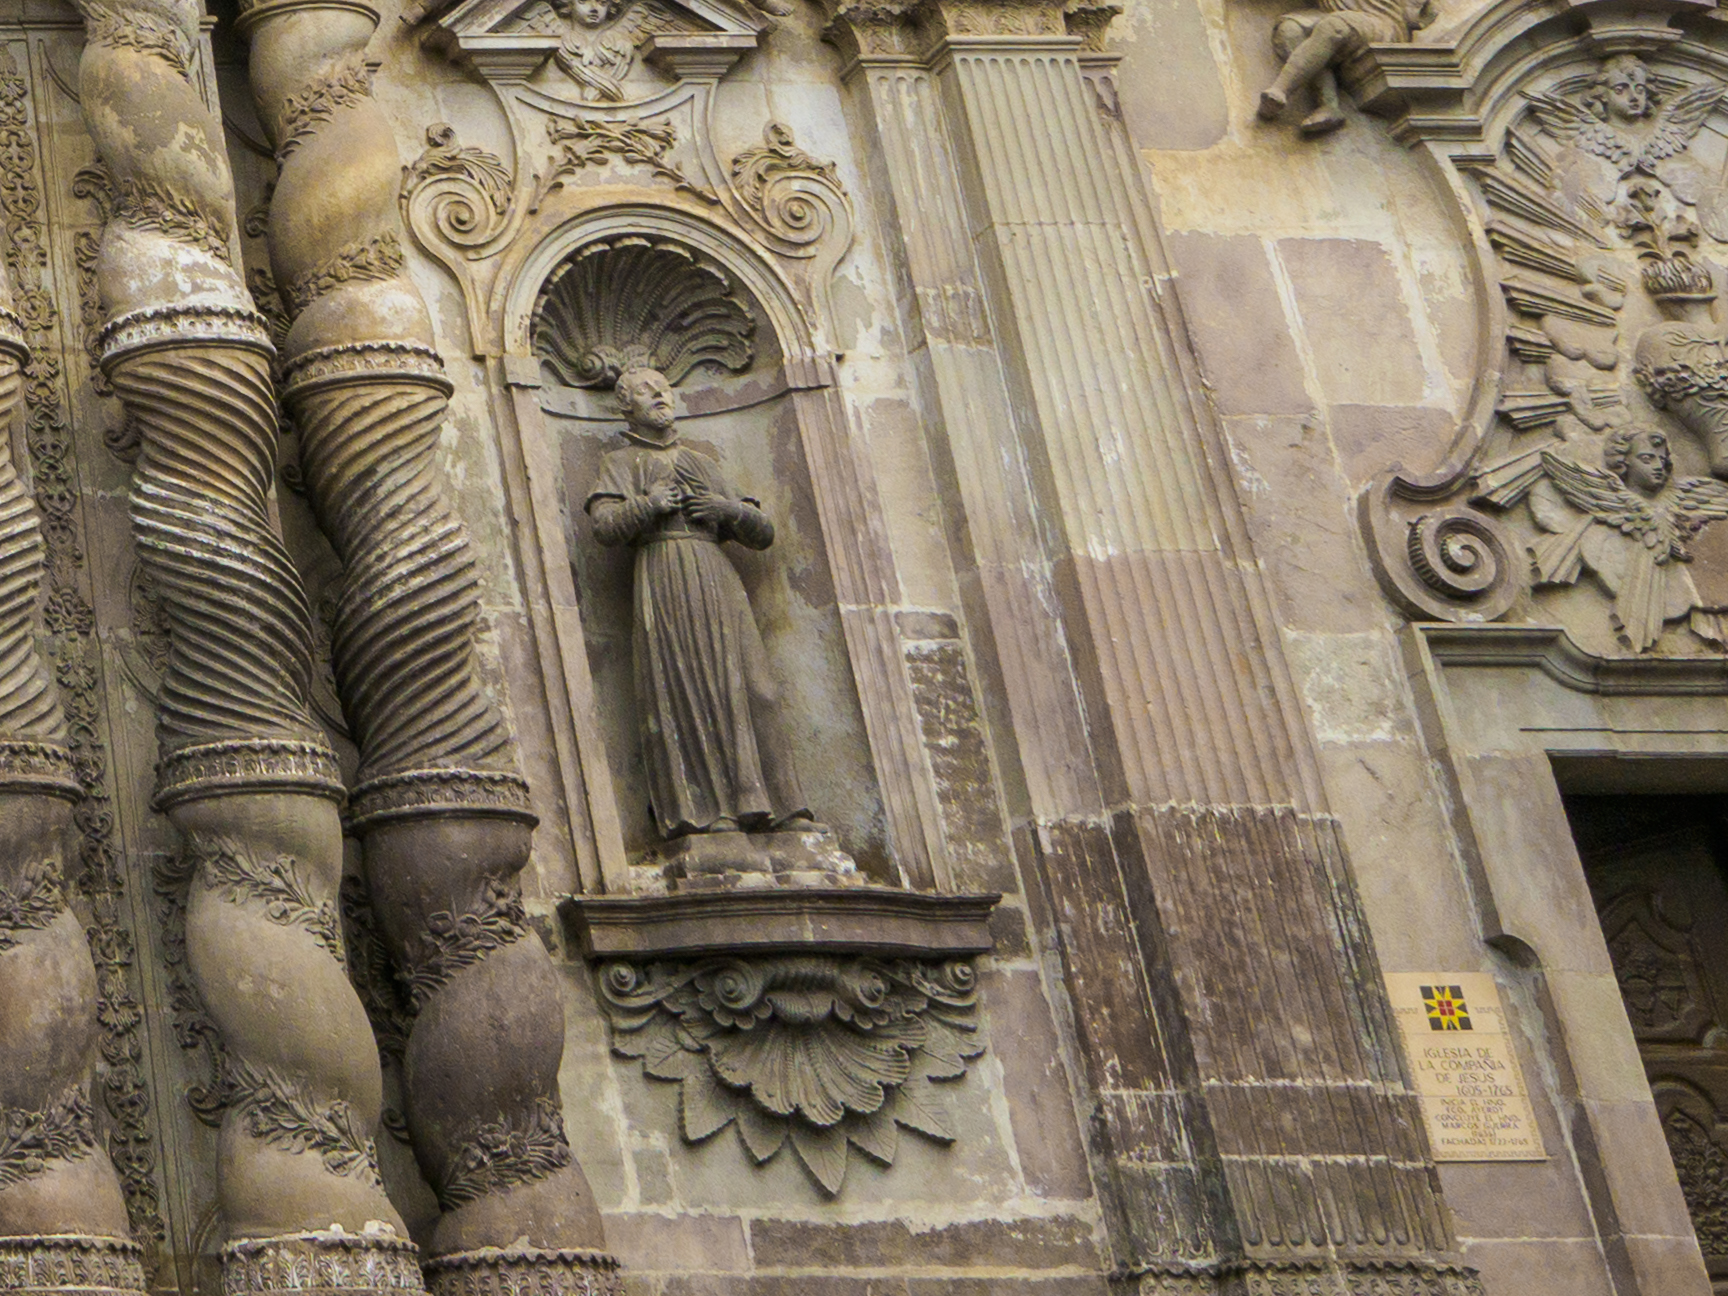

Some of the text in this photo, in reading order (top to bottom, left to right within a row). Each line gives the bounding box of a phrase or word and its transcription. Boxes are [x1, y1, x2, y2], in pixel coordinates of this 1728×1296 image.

[1423, 1047, 1494, 1059] IGLESIA DE
[1418, 1059, 1436, 1071] LA
[1435, 1072, 1496, 1084] DE JESUS
